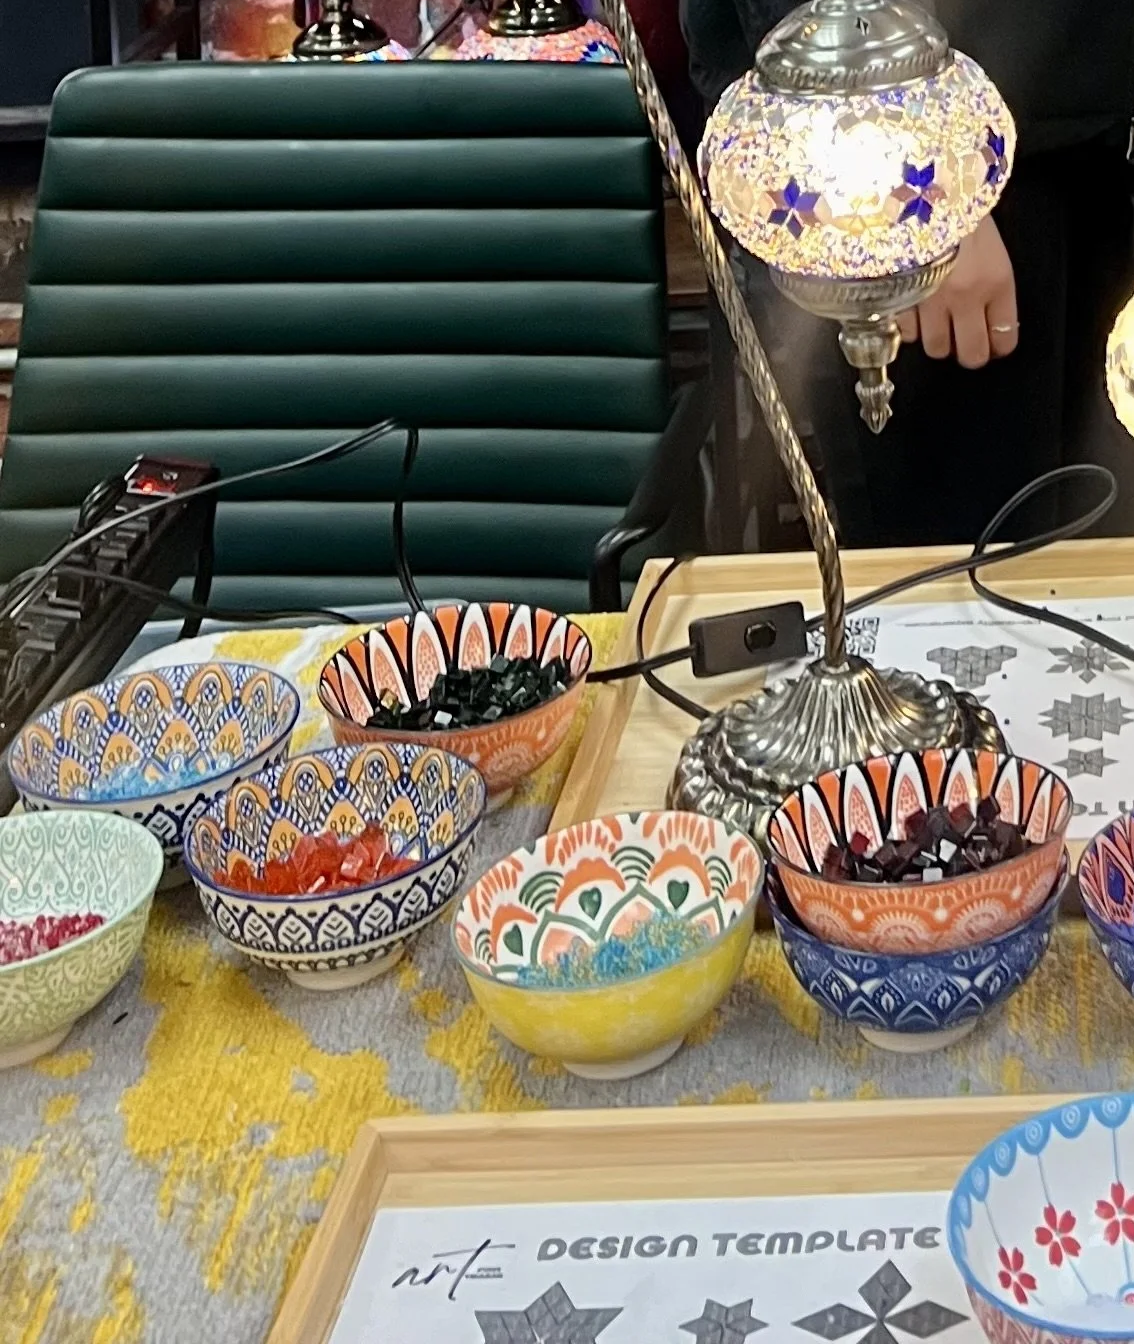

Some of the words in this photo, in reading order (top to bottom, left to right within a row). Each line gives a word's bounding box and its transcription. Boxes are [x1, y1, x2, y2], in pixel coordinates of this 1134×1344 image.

[536, 1234, 698, 1262] DESIGN
[711, 1226, 942, 1257] TEMPLATE
[391, 1238, 516, 1302] art
